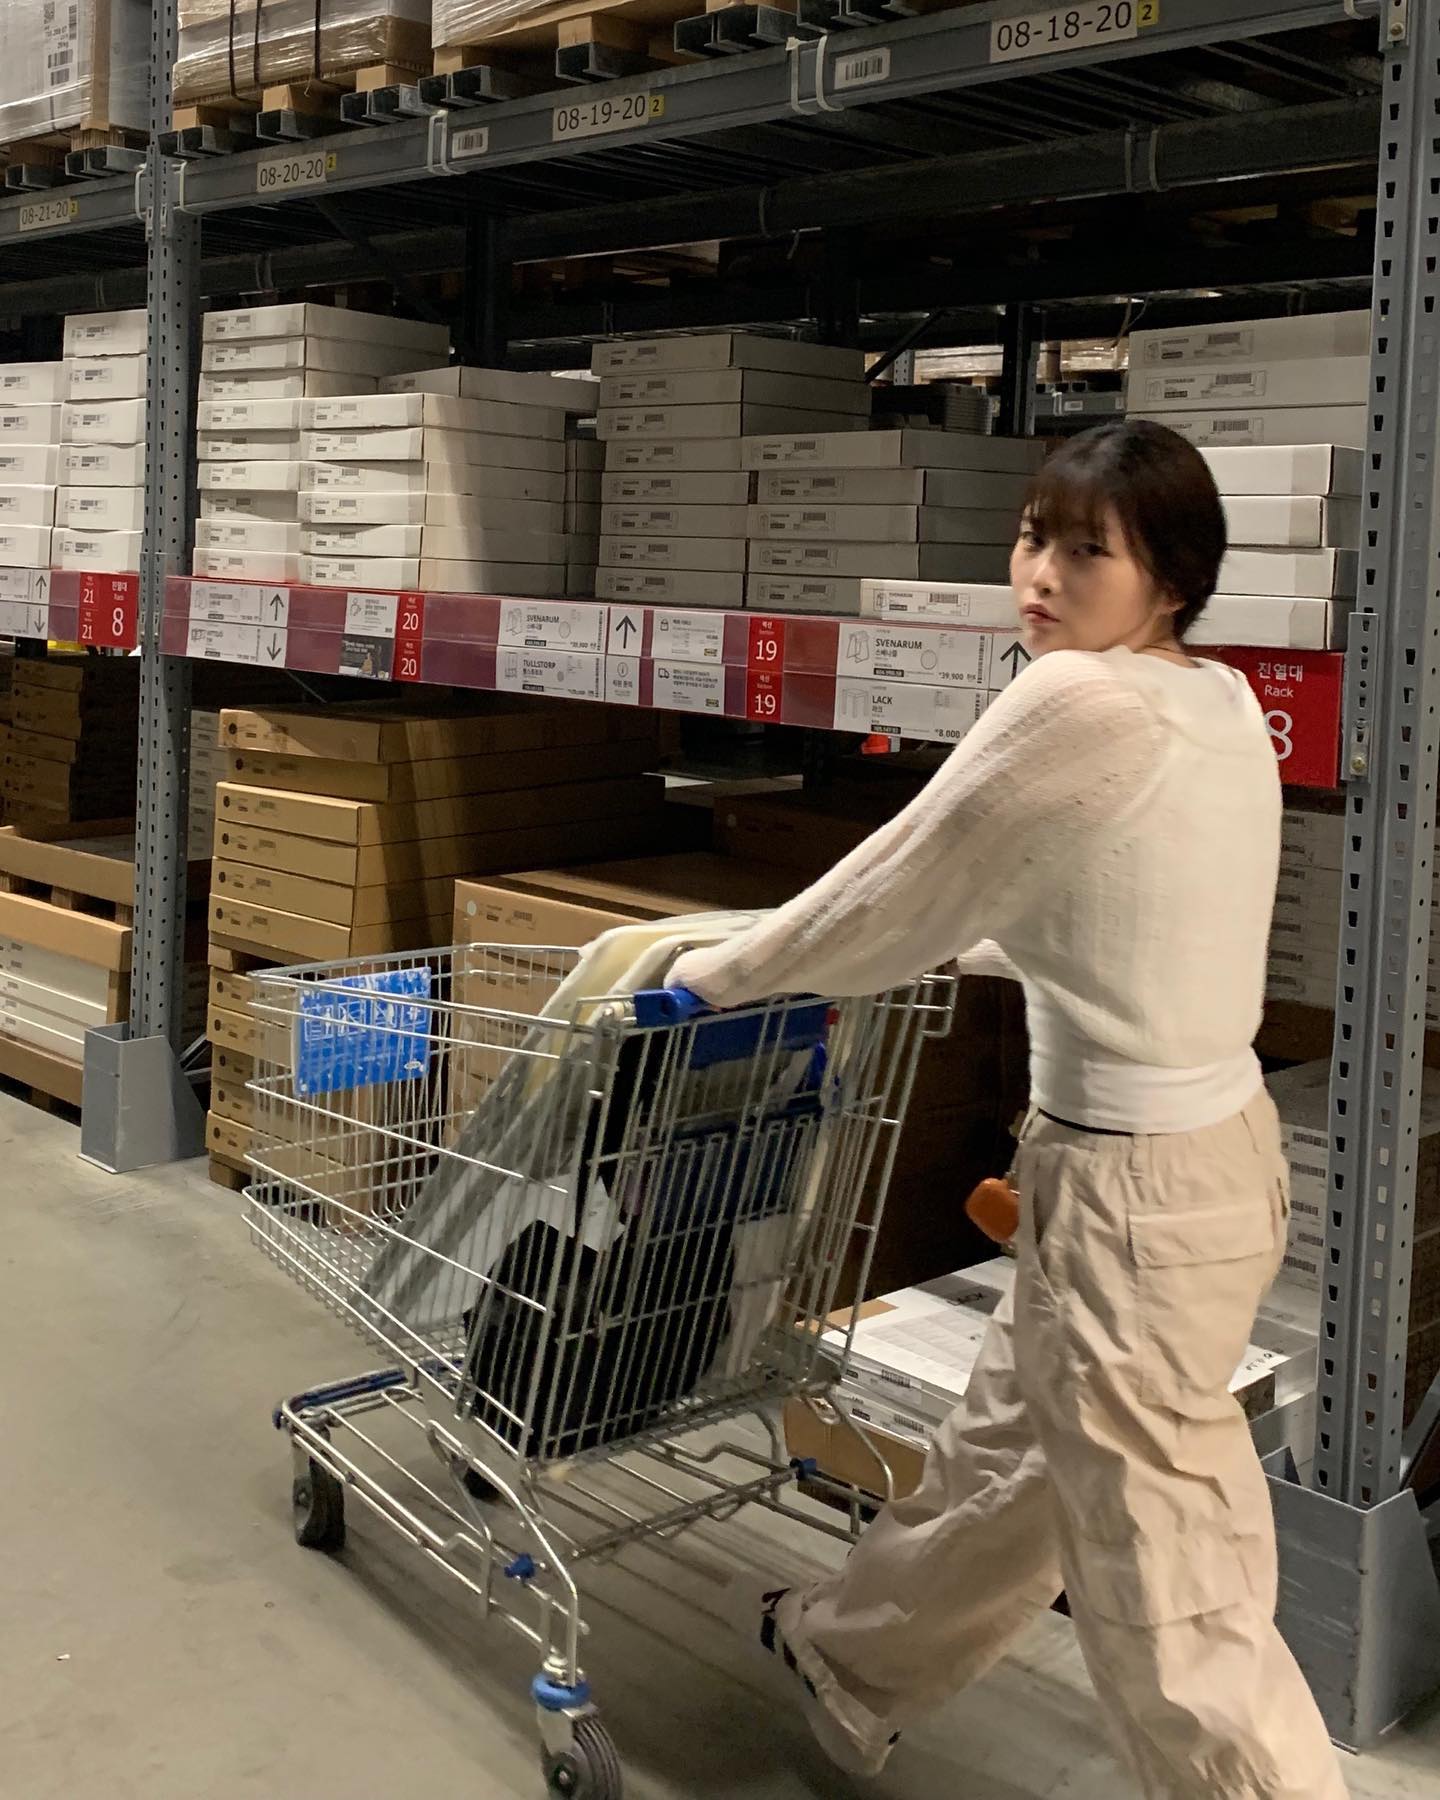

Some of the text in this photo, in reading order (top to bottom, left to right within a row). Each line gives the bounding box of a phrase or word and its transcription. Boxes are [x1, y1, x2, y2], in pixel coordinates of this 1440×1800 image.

[1141, 4, 1153, 21] 2
[997, 1, 1132, 51] 08-18-20
[555, 94, 646, 134] 08-19-20
[651, 98, 661, 114] 2
[327, 155, 335, 170] 2
[258, 157, 325, 188] 08-20-20
[21, 200, 69, 225] 08-21-20
[83, 587, 95, 604] 21
[111, 607, 124, 637] 8
[402, 612, 419, 631] 20
[81, 624, 93, 640] 21
[755, 639, 778, 662] 19
[875, 638, 923, 650] SVENARUM
[400, 657, 417, 676] 20
[1257, 661, 1304, 683] 진열대
[872, 695, 893, 705] LACK
[1264, 684, 1294, 698] Rack
[754, 693, 776, 715] 19
[1264, 709, 1293, 761] 8
